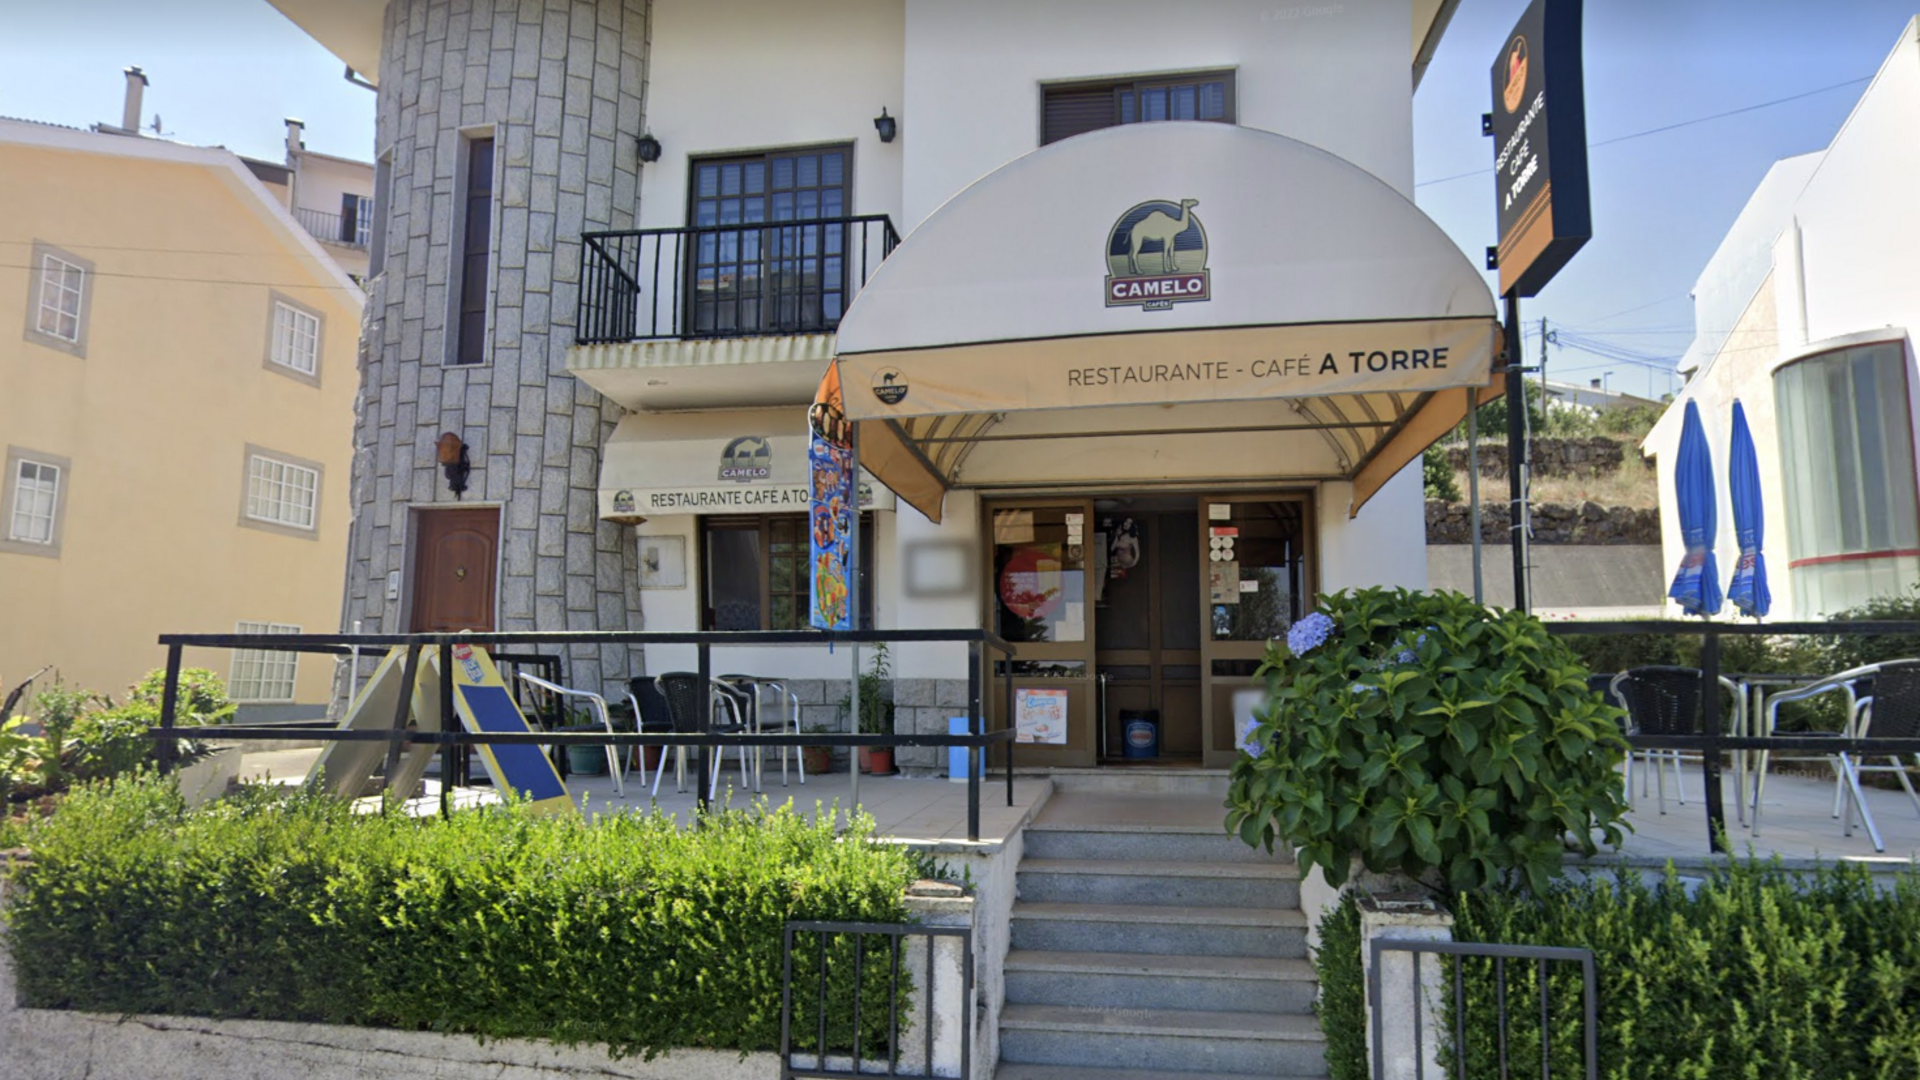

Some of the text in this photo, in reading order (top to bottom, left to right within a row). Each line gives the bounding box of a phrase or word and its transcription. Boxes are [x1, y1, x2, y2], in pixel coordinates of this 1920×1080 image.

[1495, 91, 1545, 174] RESTAURANTE
[1505, 154, 1538, 210] A TORRE
[1112, 278, 1202, 298] CAMELO
[1068, 361, 1229, 387] RESTAURANTE
[1251, 354, 1311, 378] CAFÉ
[1318, 353, 1339, 375] A
[1348, 347, 1449, 374] TORRE
[722, 468, 767, 477] CAMELO
[651, 490, 742, 507] RESTAURANTE
[744, 487, 778, 505] CAFÉ
[781, 490, 791, 502] A
